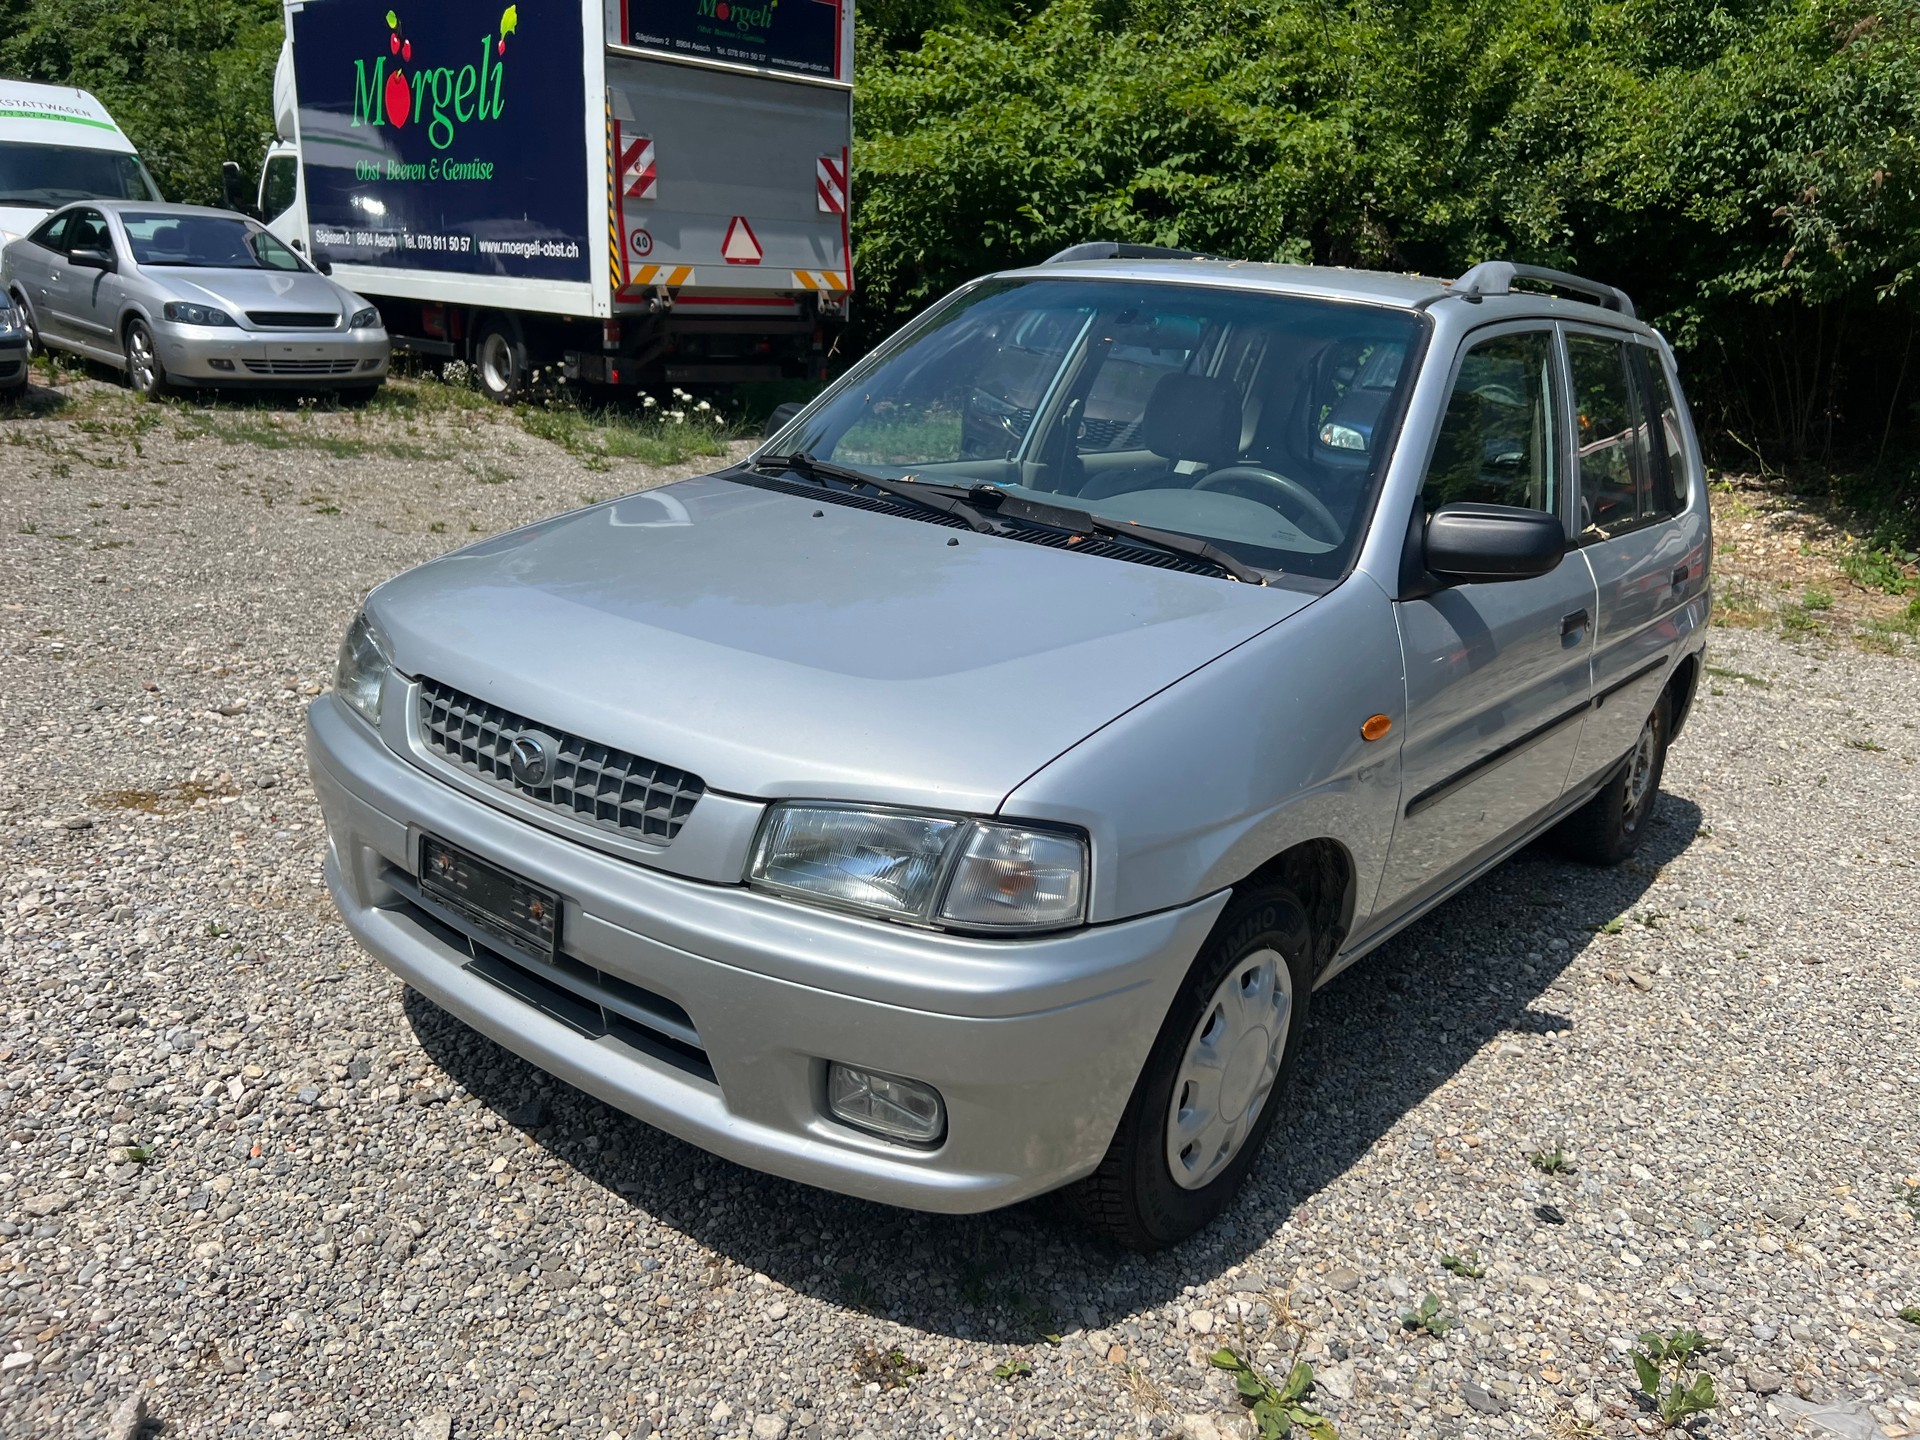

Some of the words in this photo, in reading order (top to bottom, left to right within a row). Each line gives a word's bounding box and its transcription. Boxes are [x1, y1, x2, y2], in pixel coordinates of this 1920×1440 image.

[355, 160, 381, 181] Obst
[386, 160, 426, 181] Beeren
[429, 158, 439, 181] &
[442, 157, 494, 181] Gemüse
[345, 231, 350, 245] 2
[357, 231, 373, 246] 8904
[374, 232, 397, 247] Aesch
[403, 234, 417, 249] Tel.
[418, 235, 432, 250] 078
[433, 235, 447, 250] 911
[449, 236, 459, 251] 50
[461, 237, 471, 252] 57
[478, 239, 579, 258] www.moergeli-obst.ch
[636, 237, 648, 249] 40
